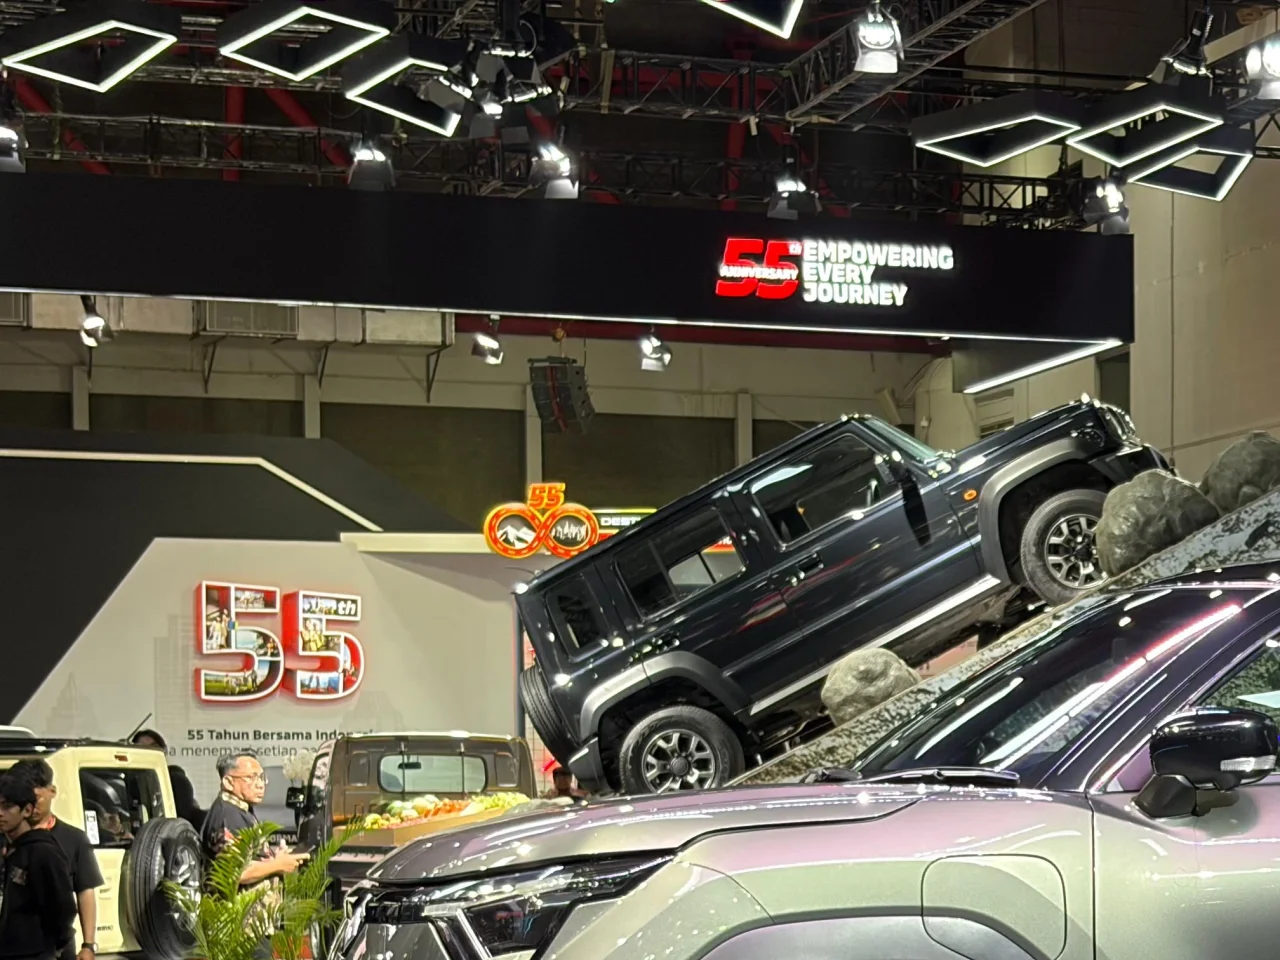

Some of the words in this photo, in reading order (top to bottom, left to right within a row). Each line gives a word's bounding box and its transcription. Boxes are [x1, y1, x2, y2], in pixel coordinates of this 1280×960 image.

[802, 238, 955, 270] EMPOWERING
[719, 265, 799, 281] ANNIVERSARY
[802, 262, 876, 284] EVERY
[802, 282, 908, 306] JOURNEY
[527, 482, 566, 509] 55
[187, 729, 204, 741] 55
[208, 729, 250, 741] Tahun
[253, 729, 312, 741] Bersama
